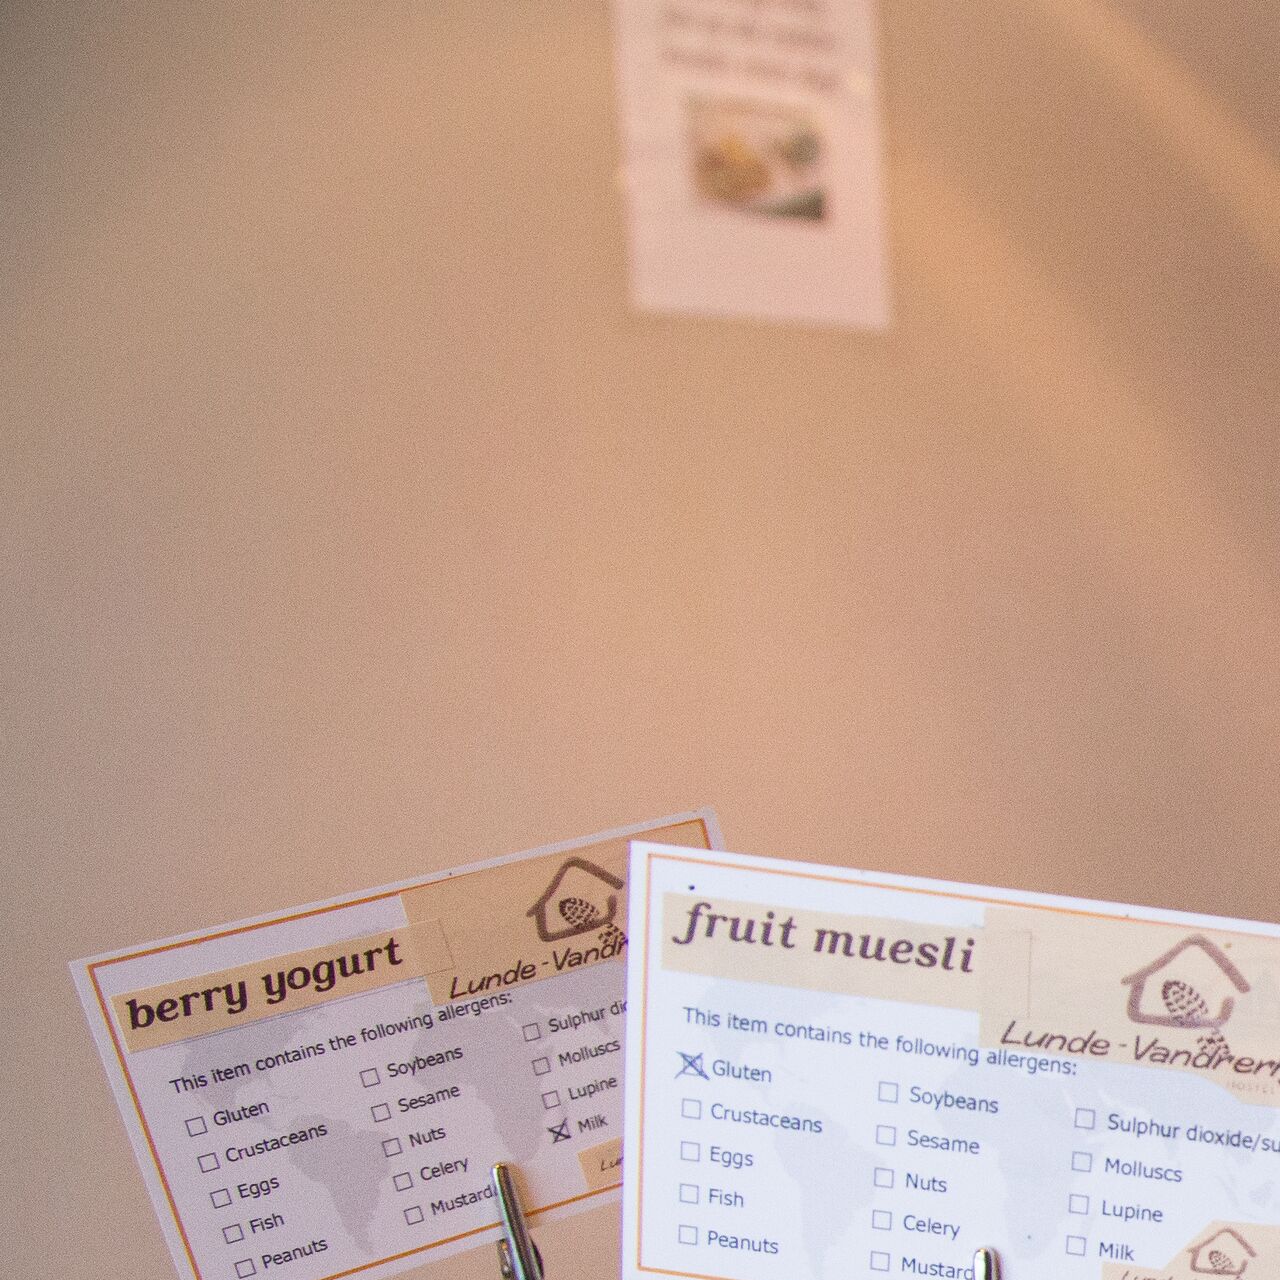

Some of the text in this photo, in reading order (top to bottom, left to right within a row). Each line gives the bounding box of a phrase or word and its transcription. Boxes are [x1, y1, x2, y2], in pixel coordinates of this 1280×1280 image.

[672, 902, 976, 973] fruit muesli
[126, 937, 403, 1030] berry yogurt
[548, 1007, 606, 1033] Sulphur
[169, 992, 512, 1094] This item contains the following allergens:
[558, 1040, 621, 1067] Molluscs
[683, 1006, 1077, 1076] This item contains the following allergens:
[387, 1047, 464, 1078] Soybeans
[712, 1058, 772, 1083] Gluten
[398, 1083, 461, 1113] Sesame
[568, 1076, 618, 1101] Lupine
[909, 1086, 999, 1114] Soybeans
[213, 1100, 270, 1128] Gluten
[577, 1114, 608, 1133] Milk
[710, 1102, 823, 1134] Crustaceans
[1108, 1113, 1180, 1141] Sulphur
[225, 1122, 328, 1164] Crustaceans
[410, 1125, 447, 1148] Nuts
[907, 1130, 981, 1155] Sesame
[420, 1158, 468, 1181] Celery
[710, 1146, 754, 1168] Eggs
[1104, 1157, 1183, 1184] Molluscs
[237, 1175, 280, 1201] Eggs
[905, 1172, 948, 1193] Nuts
[431, 1184, 494, 1216] Mustard
[709, 1187, 744, 1208] Fish
[1102, 1199, 1163, 1223] Lupine
[249, 1212, 285, 1235] Fish
[903, 1214, 960, 1241] Celery
[262, 1237, 328, 1270] Peanuts
[707, 1230, 779, 1256] Peanuts
[1098, 1241, 1135, 1262] Milk
